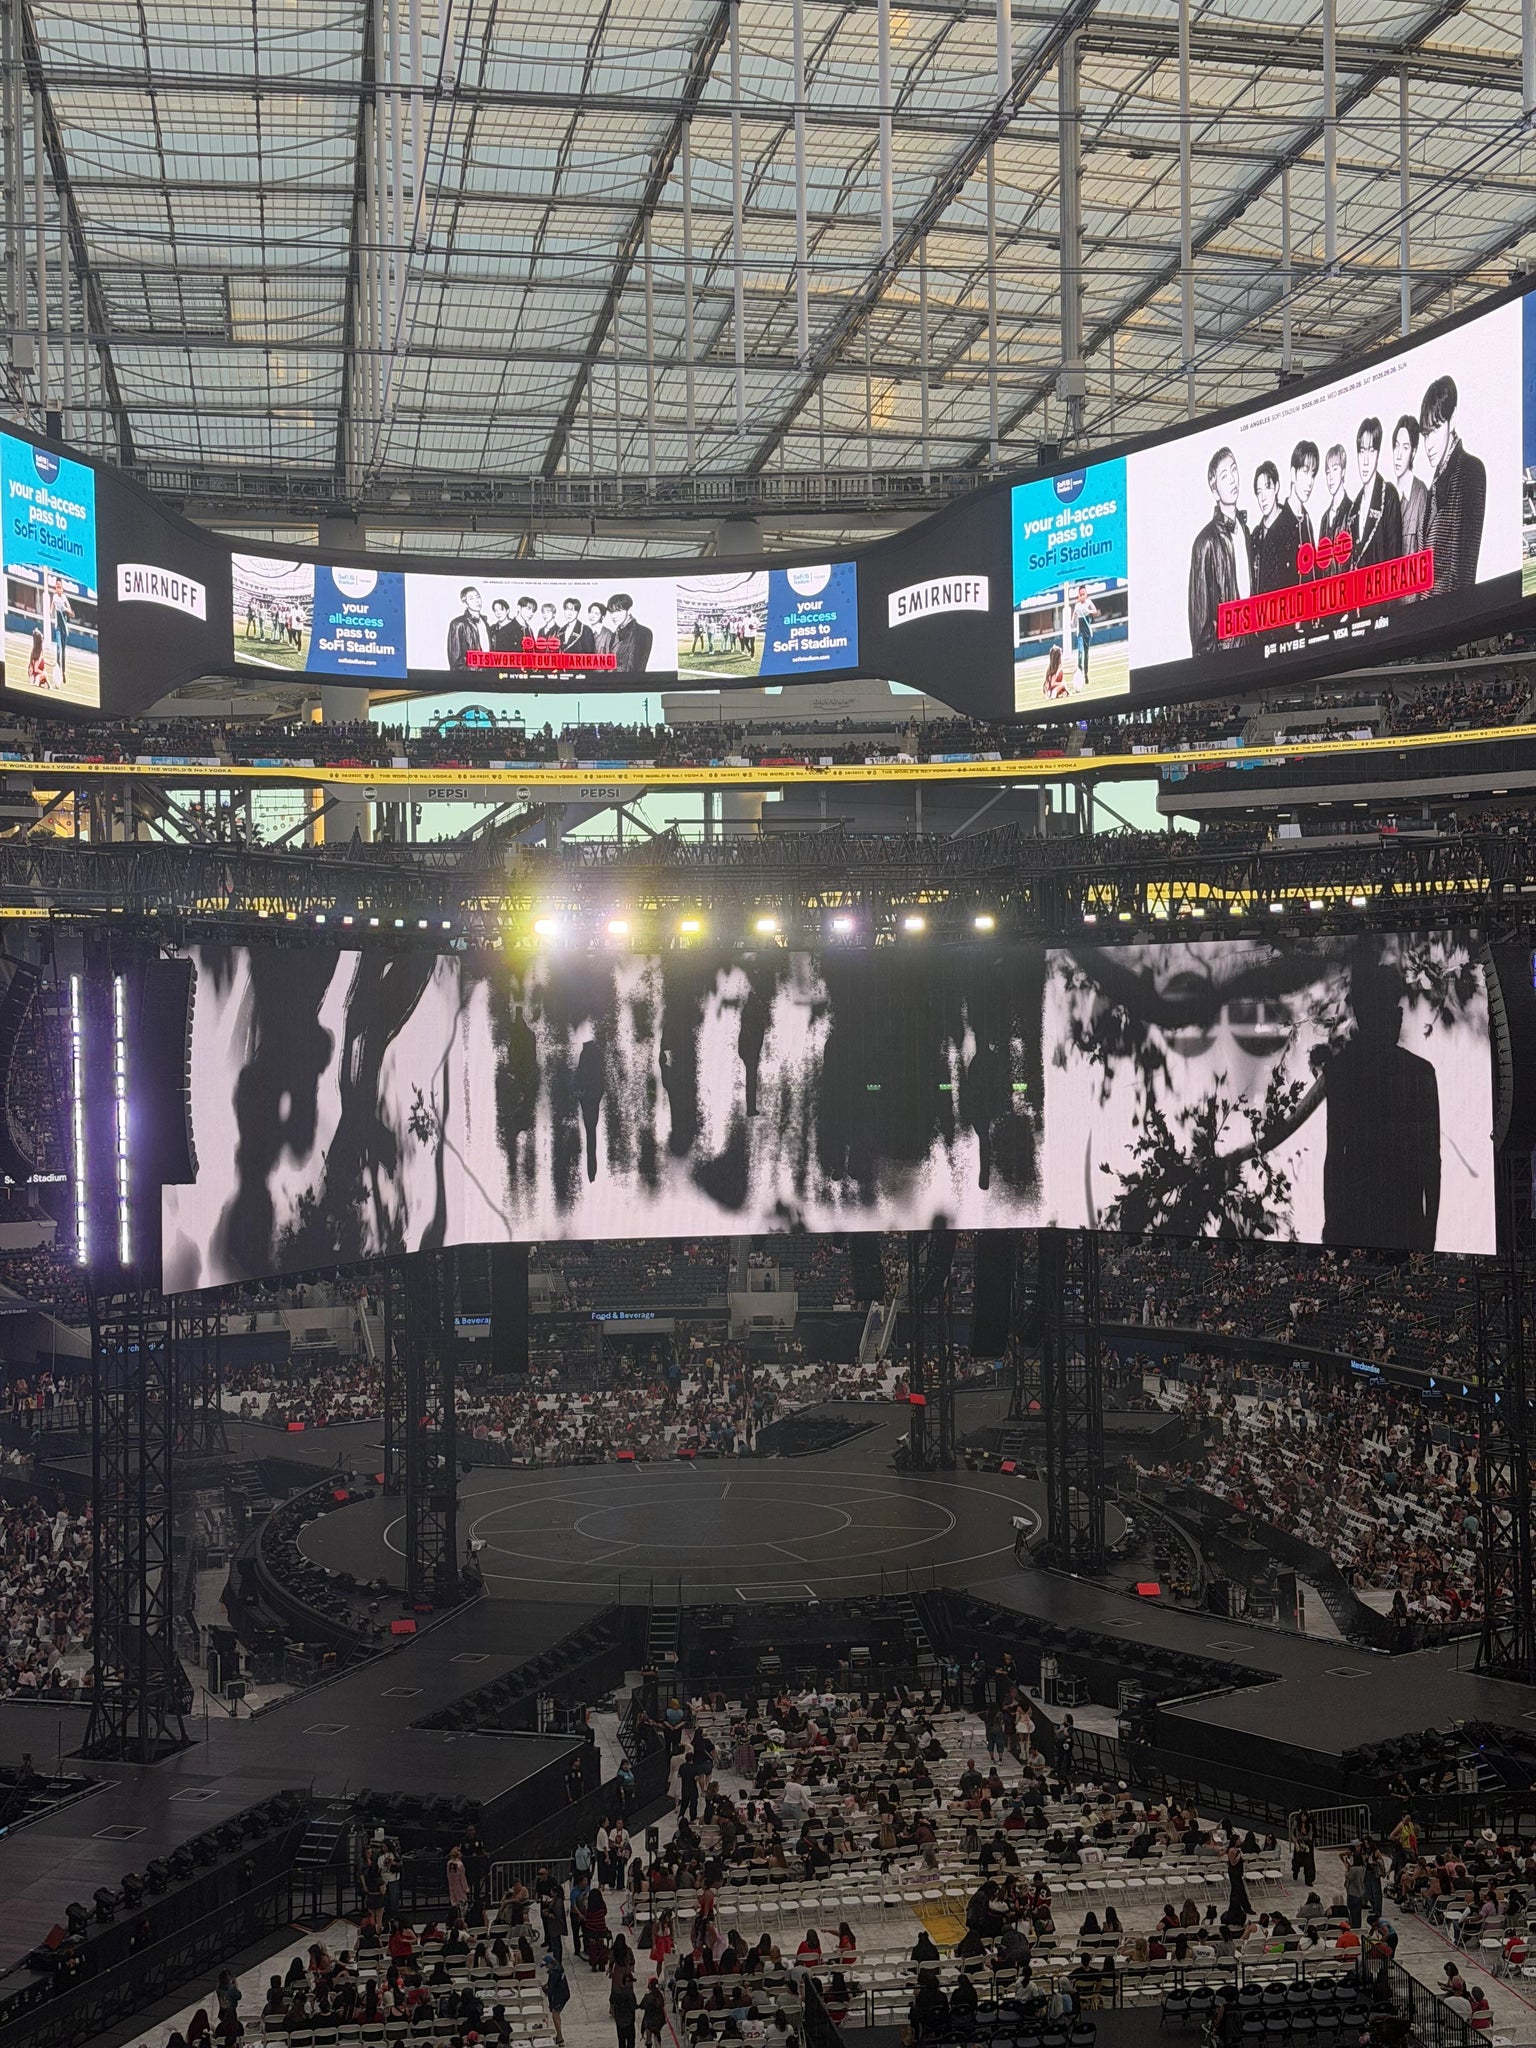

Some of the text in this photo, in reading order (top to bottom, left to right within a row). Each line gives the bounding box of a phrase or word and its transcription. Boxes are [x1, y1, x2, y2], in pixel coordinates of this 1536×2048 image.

[8, 479, 87, 520] your all-access
[29, 505, 67, 531] pass to
[1024, 500, 1117, 540] your all-access
[14, 518, 84, 557] SoFi Stadium
[1048, 523, 1094, 551] pass to
[1029, 539, 1113, 570] SoFi Stadium
[124, 571, 198, 608] SMIRNOFF
[1224, 555, 1427, 635] BTS WORLD TOUR ARIRANG
[797, 600, 824, 614] your
[898, 582, 980, 617] SMIRNOFF
[342, 603, 369, 615] your
[328, 613, 384, 628] all-access
[783, 612, 838, 625] all-access
[336, 628, 377, 639] pass to
[790, 623, 831, 639] pass to
[319, 638, 395, 655] SoFi Stadium
[773, 636, 848, 652] SoFi Stadium
[1279, 638, 1306, 653] HYBE
[472, 654, 612, 667] BTS WORLD TOUR ARIRANG
[428, 789, 468, 798] PEPSI
[581, 789, 620, 798] PEPSI
[33, 1173, 67, 1183] Stadium
[592, 1312, 611, 1320] Food
[620, 1311, 655, 1320] Beverage
[1350, 1359, 1381, 1374] Merchandise
